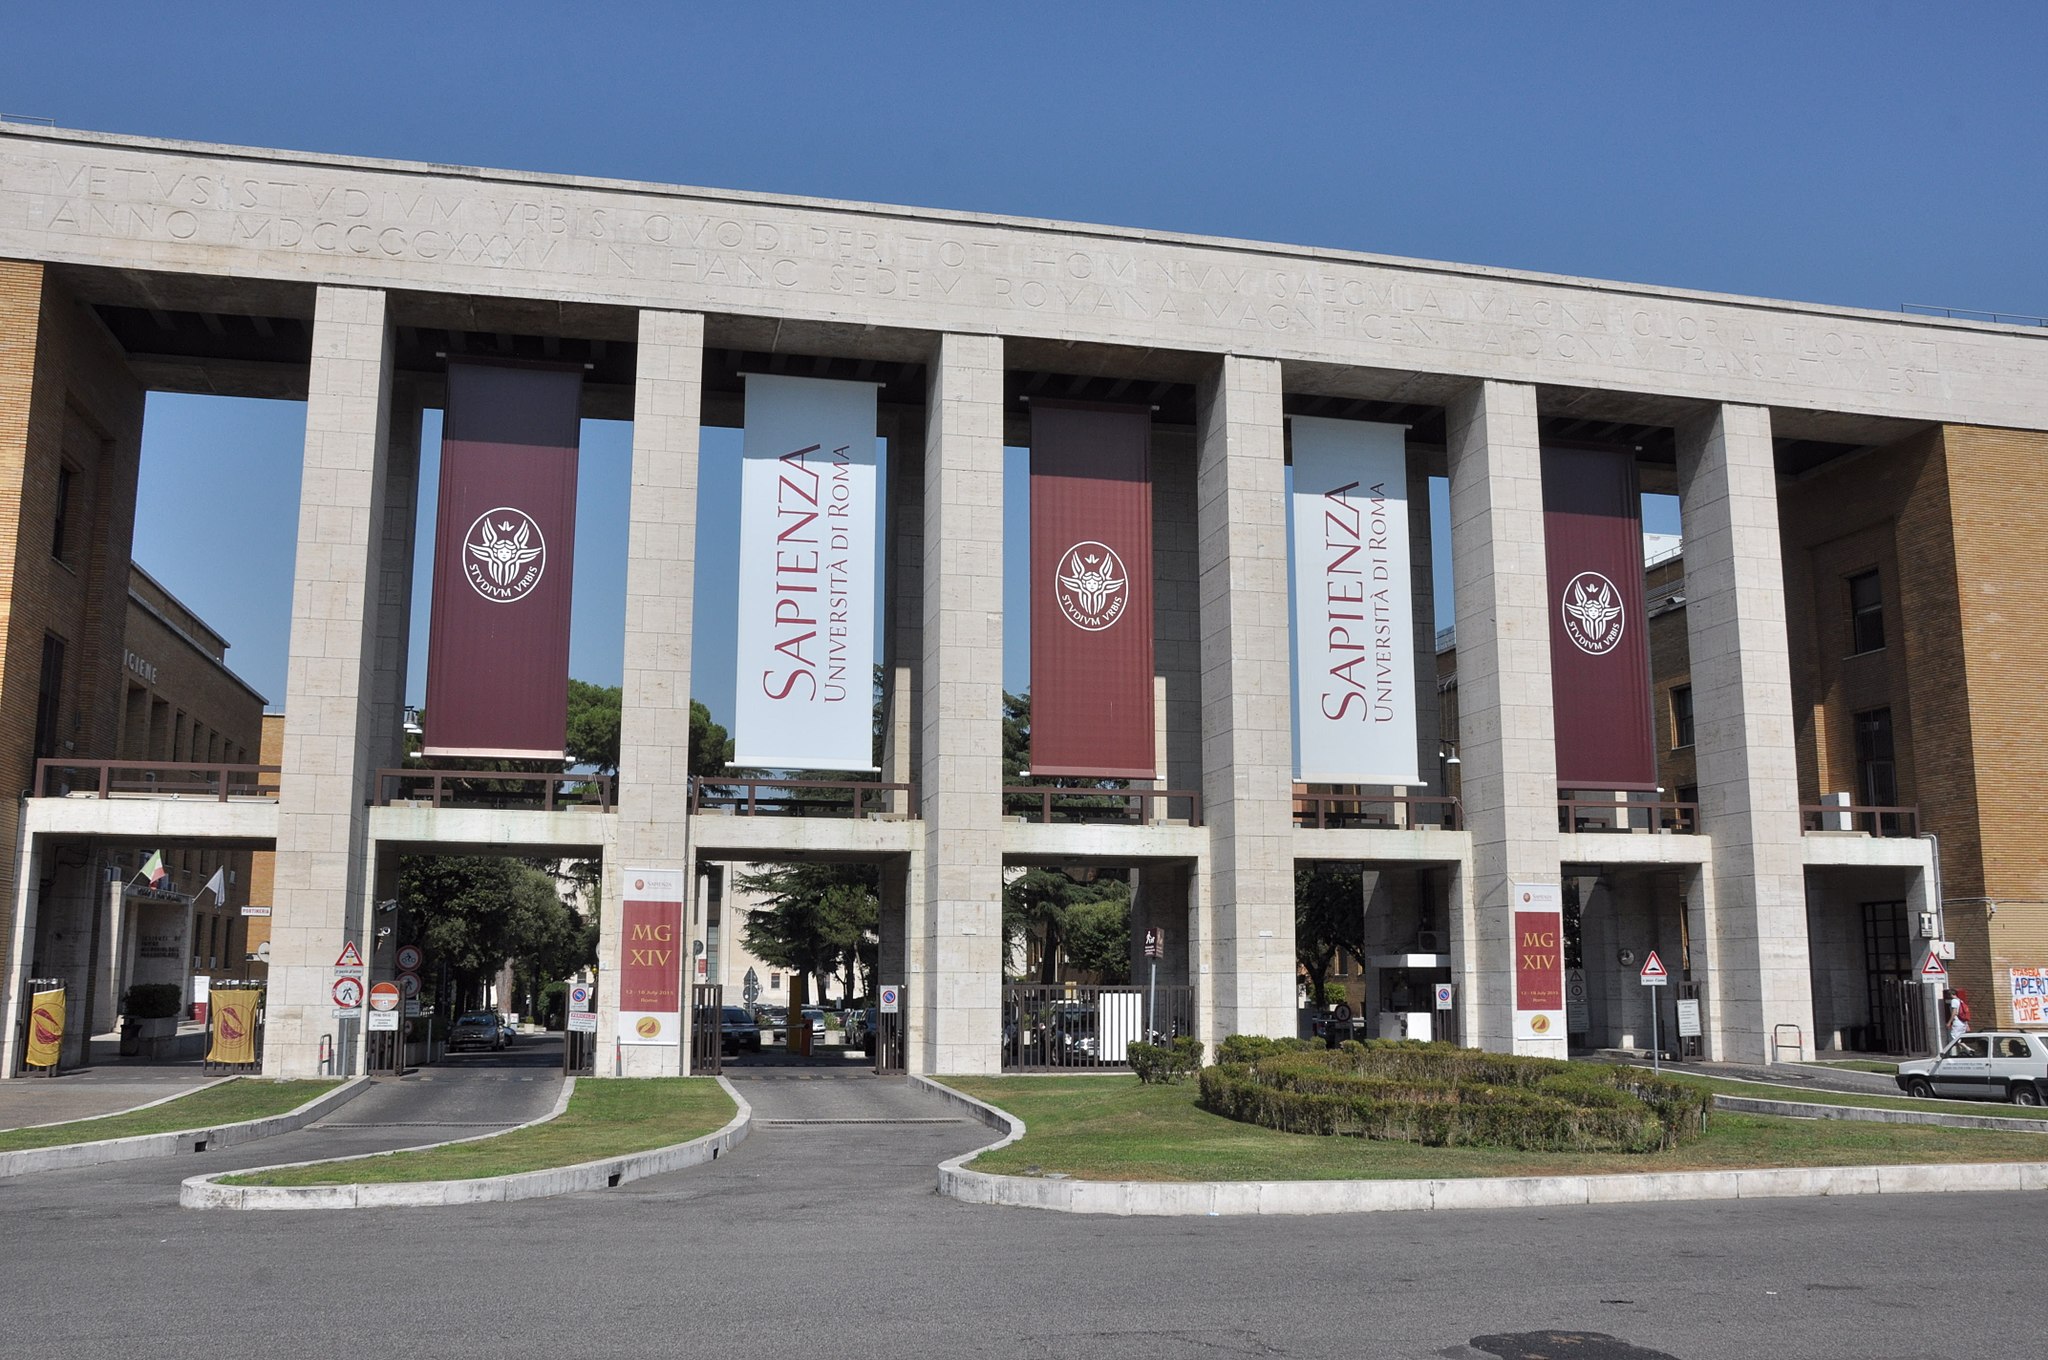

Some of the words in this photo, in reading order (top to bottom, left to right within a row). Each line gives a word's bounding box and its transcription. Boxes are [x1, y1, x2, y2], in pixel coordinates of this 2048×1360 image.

[48, 200, 199, 239] ANNO
[594, 243, 636, 275] IN
[670, 252, 798, 287] HANC
[830, 264, 962, 298] SEDEM
[995, 278, 1182, 320] ROMANA
[53, 162, 212, 204] VETVS
[240, 179, 463, 224] STVDIVM
[491, 200, 607, 239] VRBIS
[643, 213, 781, 251] QVOD
[811, 226, 882, 261] PER
[905, 235, 999, 271] TOT
[1274, 272, 1443, 314] SAECVLA
[1466, 295, 1607, 332] MAGNA
[827, 444, 850, 519] ROMA
[1368, 482, 1388, 552] ROMA
[831, 525, 849, 551] DI
[469, 563, 512, 597] STVDIVM
[513, 566, 538, 592] VRBIS
[763, 443, 821, 702] SAPIENZA
[1373, 558, 1388, 582] DI
[1062, 594, 1101, 626] STVDIVM
[1102, 596, 1122, 621] VRBIS
[1321, 481, 1368, 722] SAPIENZA
[824, 558, 848, 703] UNIVERSITÀ
[1568, 620, 1603, 650] STVDIVM
[1603, 622, 1620, 646] VRBIS
[123, 649, 158, 685] IGIENE
[1370, 589, 1394, 724] UNIVERSITÀ
[631, 924, 673, 942] MG
[1522, 932, 1555, 948] MG
[629, 949, 673, 967] XIV
[1522, 954, 1556, 970] XIV
[2012, 967, 2041, 977] STASERA
[2013, 996, 2040, 1010] MUSICA
[2019, 1007, 2041, 1021] LIVE
